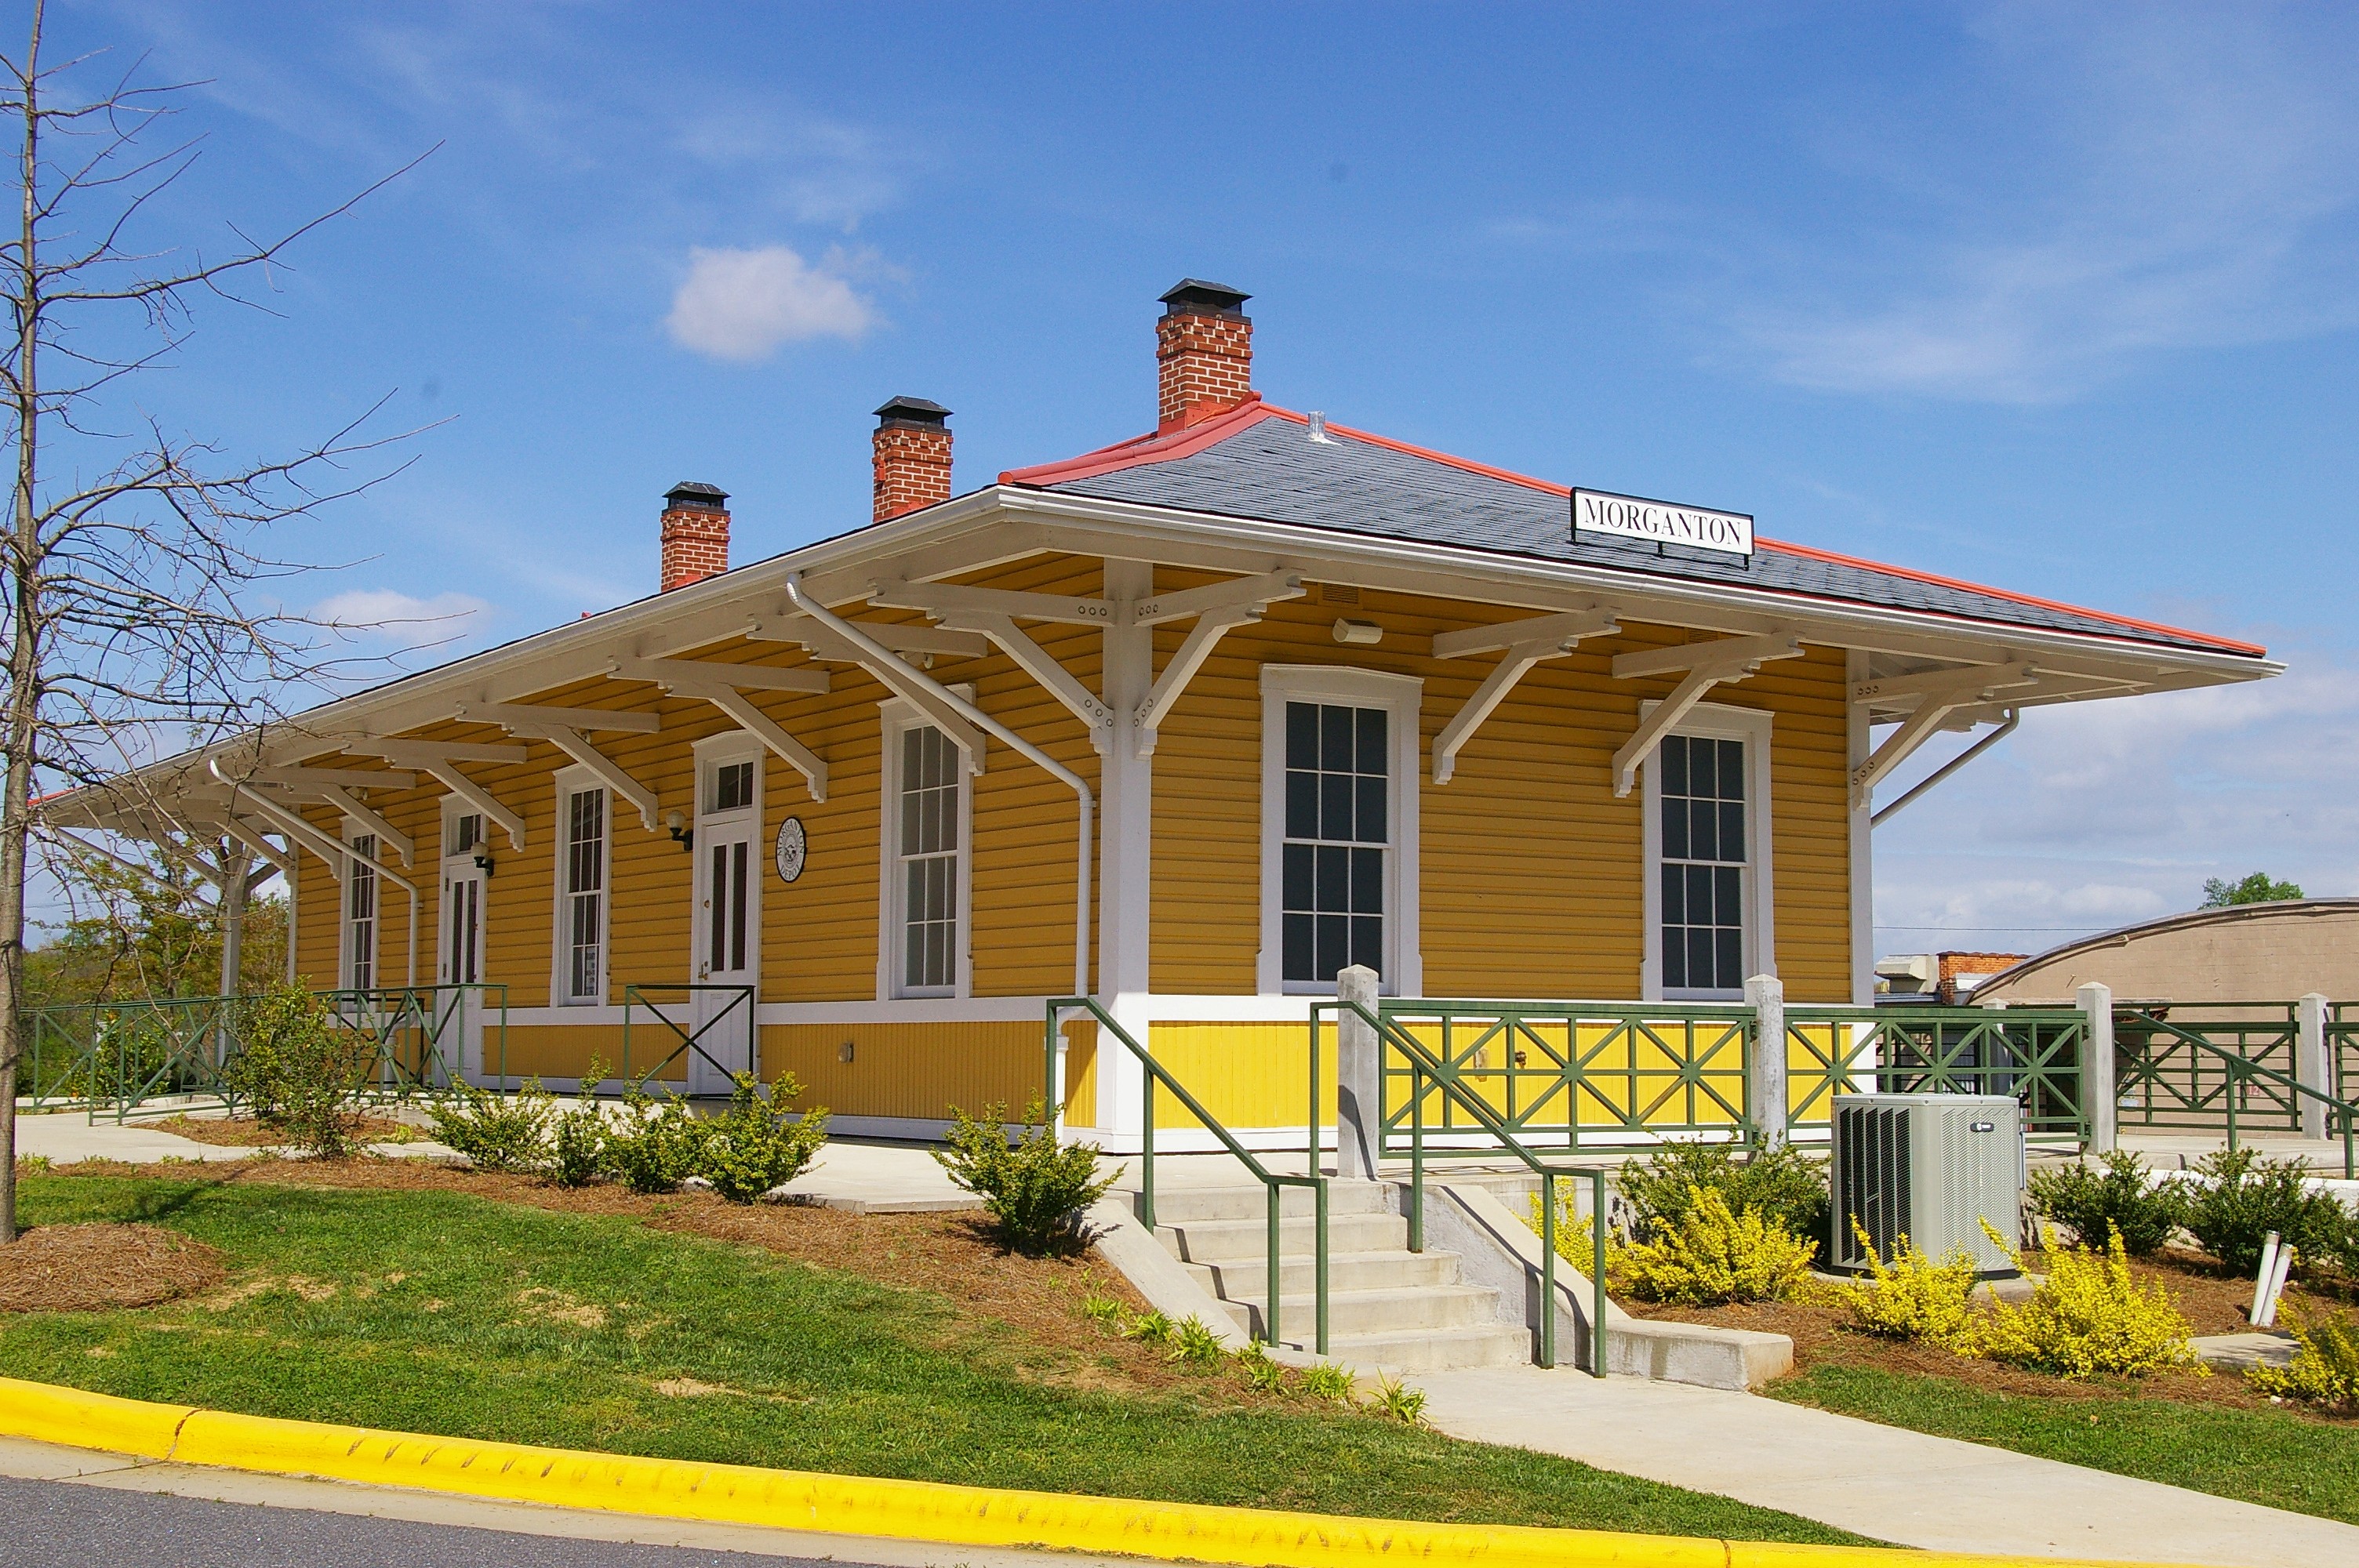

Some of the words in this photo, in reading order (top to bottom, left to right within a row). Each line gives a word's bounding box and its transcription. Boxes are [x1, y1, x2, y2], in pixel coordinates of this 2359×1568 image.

[1583, 497, 1741, 546] MORGANTON
[777, 819, 804, 856] MORGANTON
[780, 864, 800, 880] DEPOT
